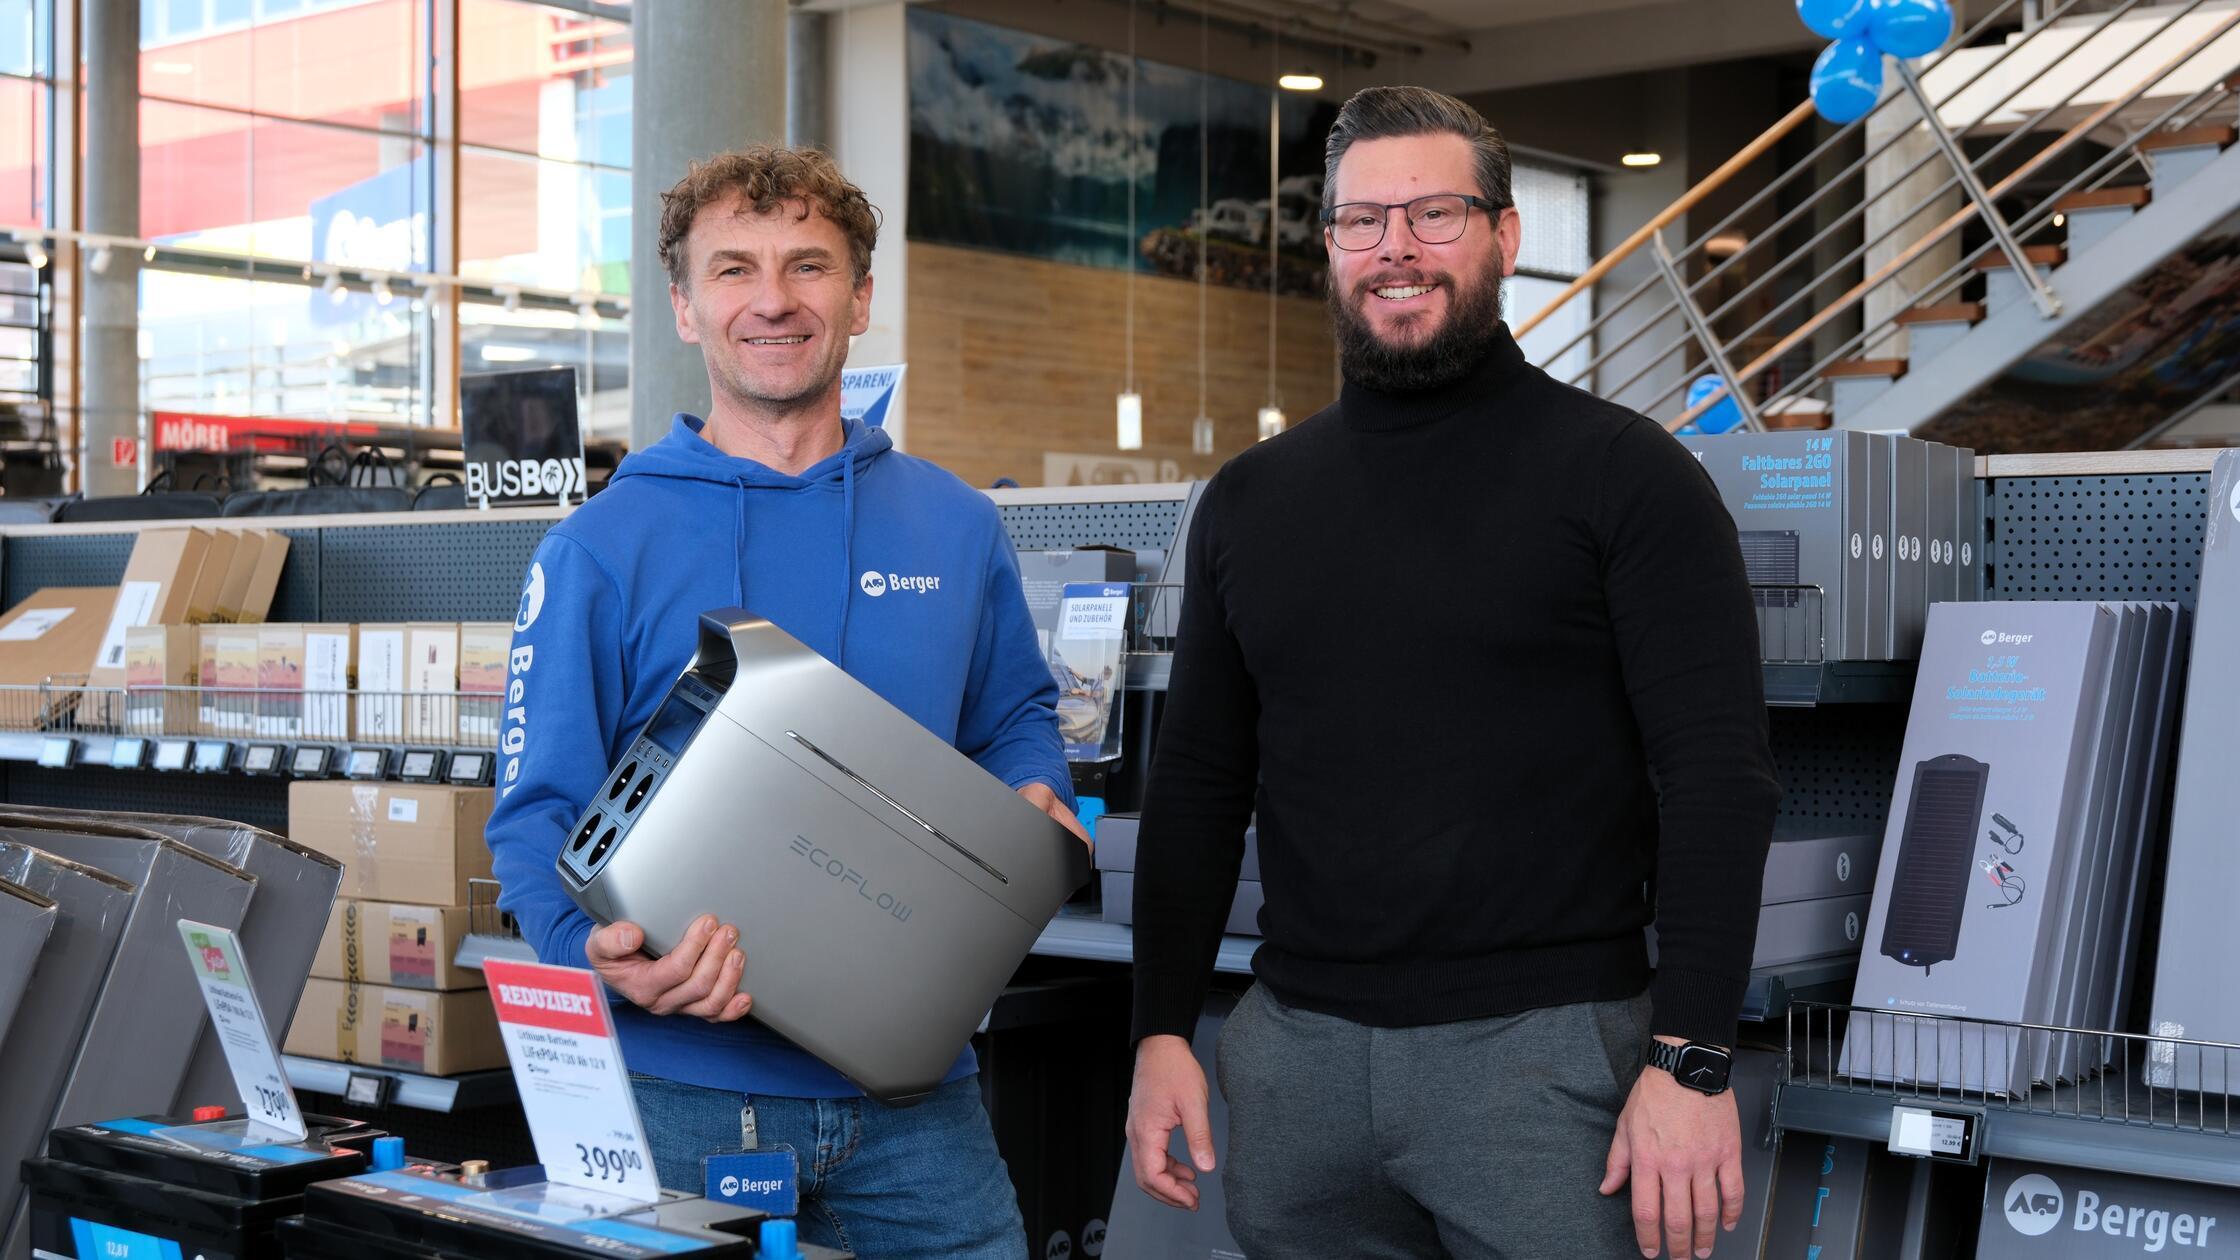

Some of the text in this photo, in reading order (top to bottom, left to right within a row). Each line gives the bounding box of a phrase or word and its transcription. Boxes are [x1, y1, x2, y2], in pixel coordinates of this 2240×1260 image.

[161, 417, 229, 451] MÖBEL
[1806, 437, 1833, 451] 14 W
[1742, 453, 1832, 471] Faltbares 2GO
[1760, 472, 1831, 491] Solarpanel
[888, 573, 940, 594] Berger
[1071, 603, 1113, 612] SOLARPANELE
[1069, 613, 1113, 623] UND ZUBEHÖR
[1997, 632, 2034, 645] Berger
[789, 834, 913, 922] ECOFLOW
[498, 984, 593, 1016] REDUZIERT
[742, 1178, 783, 1195] Berger
[2073, 1190, 2216, 1252] Berger
